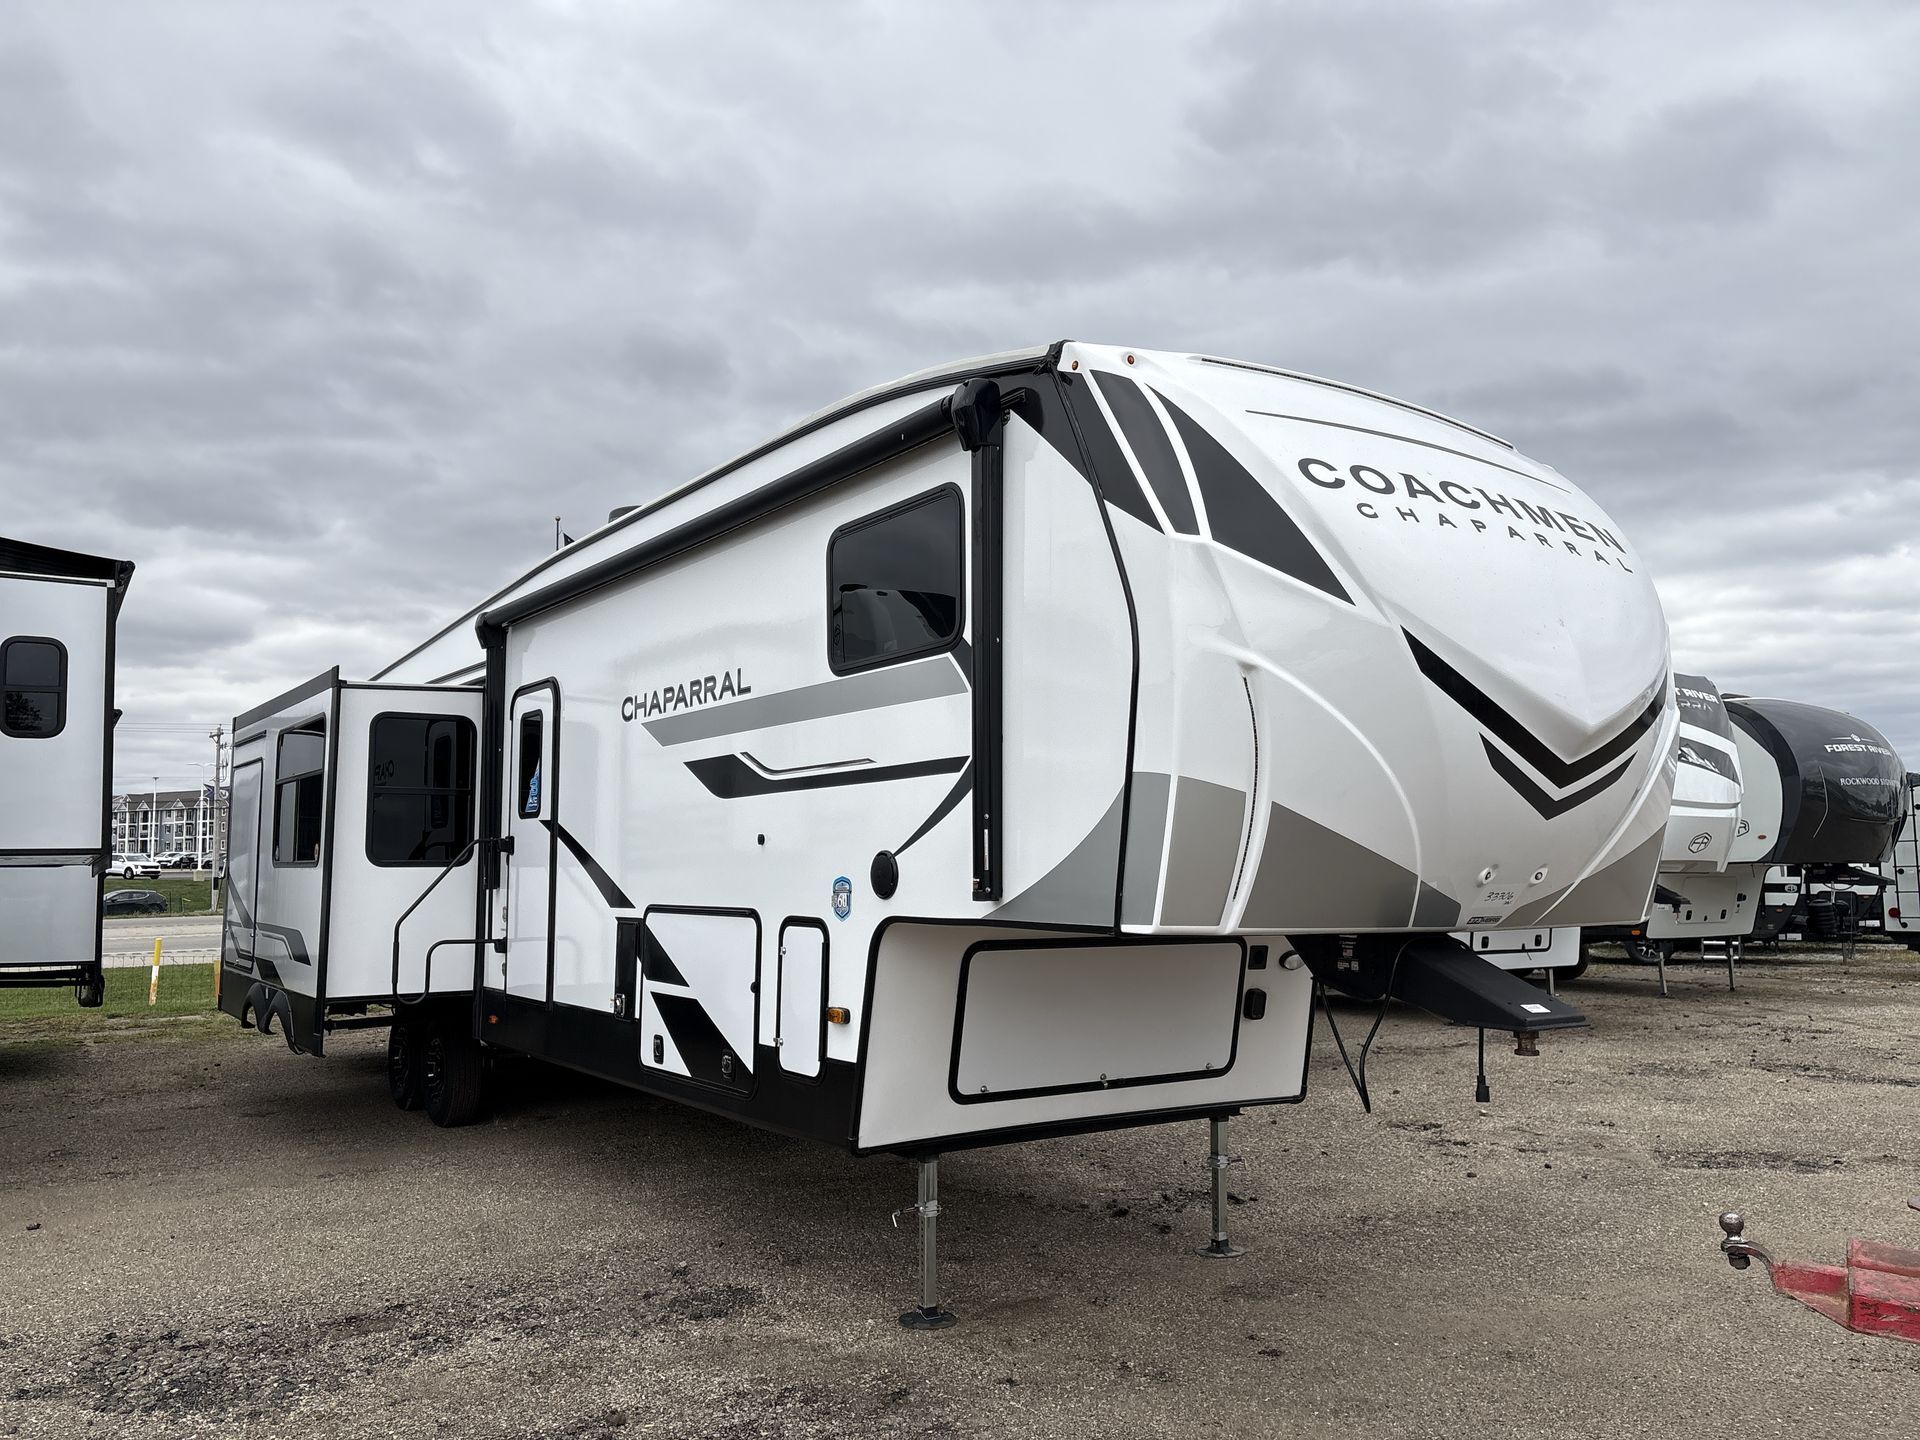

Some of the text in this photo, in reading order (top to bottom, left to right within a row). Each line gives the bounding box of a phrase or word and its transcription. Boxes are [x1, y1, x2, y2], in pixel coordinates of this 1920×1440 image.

[1298, 457, 1627, 554] COACHMEN
[1356, 502, 1634, 574] CHAPARRAL
[621, 668, 752, 722] CHAPARRAL
[1681, 688, 1719, 705] RIVER
[1824, 744, 1893, 757] FOREST RIVER
[1840, 777, 1880, 786] ROCKWOOD
